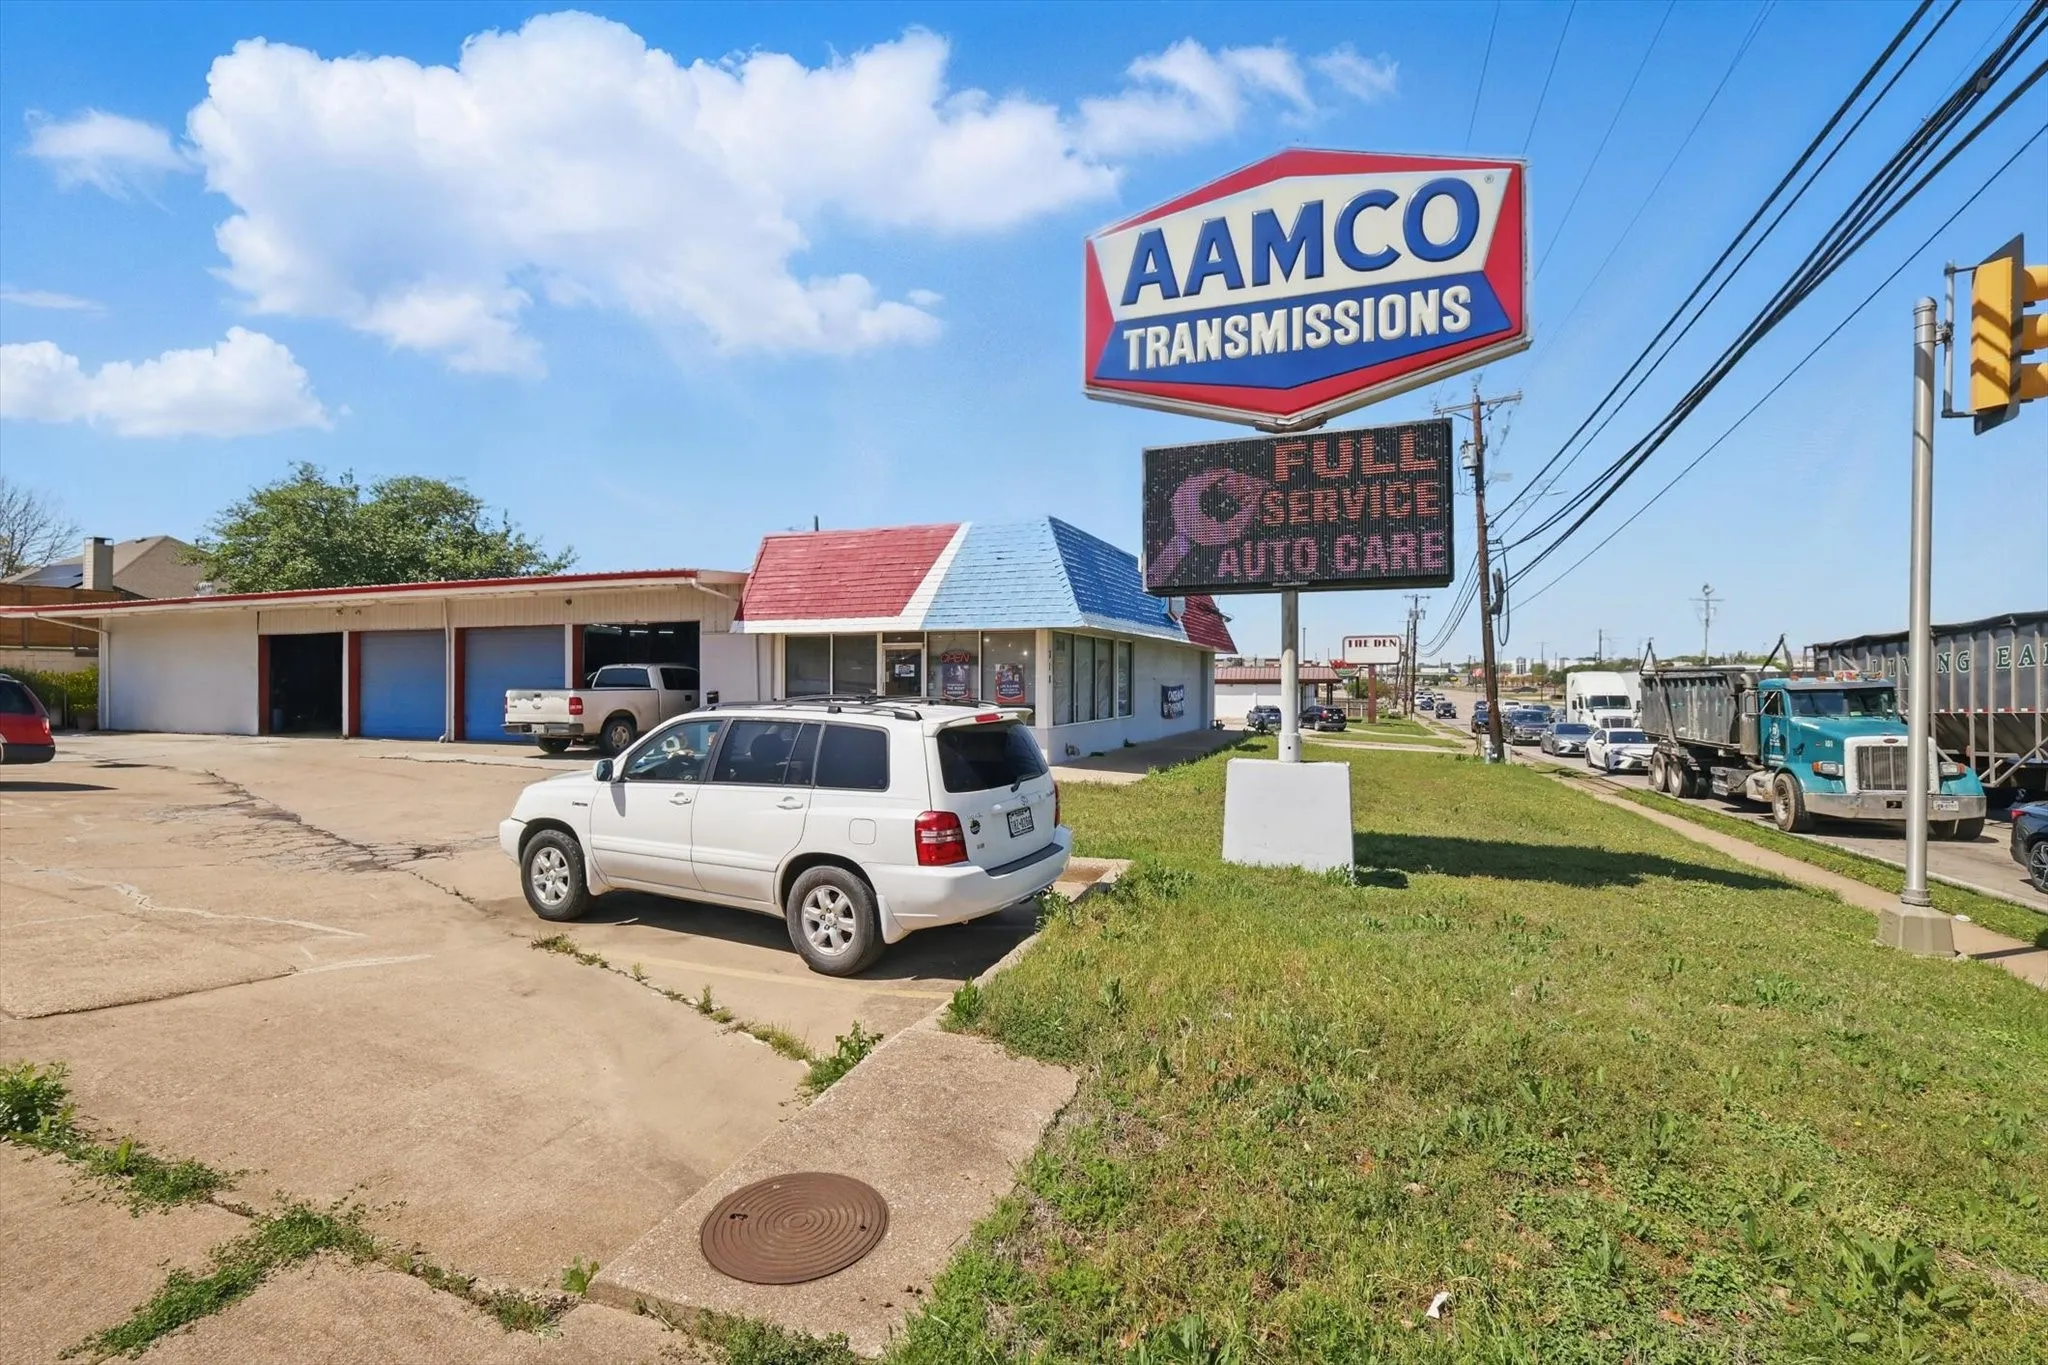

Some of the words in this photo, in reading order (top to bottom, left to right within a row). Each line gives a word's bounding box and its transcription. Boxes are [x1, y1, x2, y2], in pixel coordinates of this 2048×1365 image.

[1120, 177, 1480, 306] AAMCO
[1123, 285, 1472, 371] TRANSMISSIONS
[1274, 430, 1437, 482] FULL
[1262, 480, 1440, 527] SERVICE
[1217, 537, 1319, 578] AUTO
[1334, 530, 1445, 575] CARE
[1348, 639, 1370, 648] THE
[1374, 639, 1397, 648] DEN
[1996, 642, 2048, 669] EA
